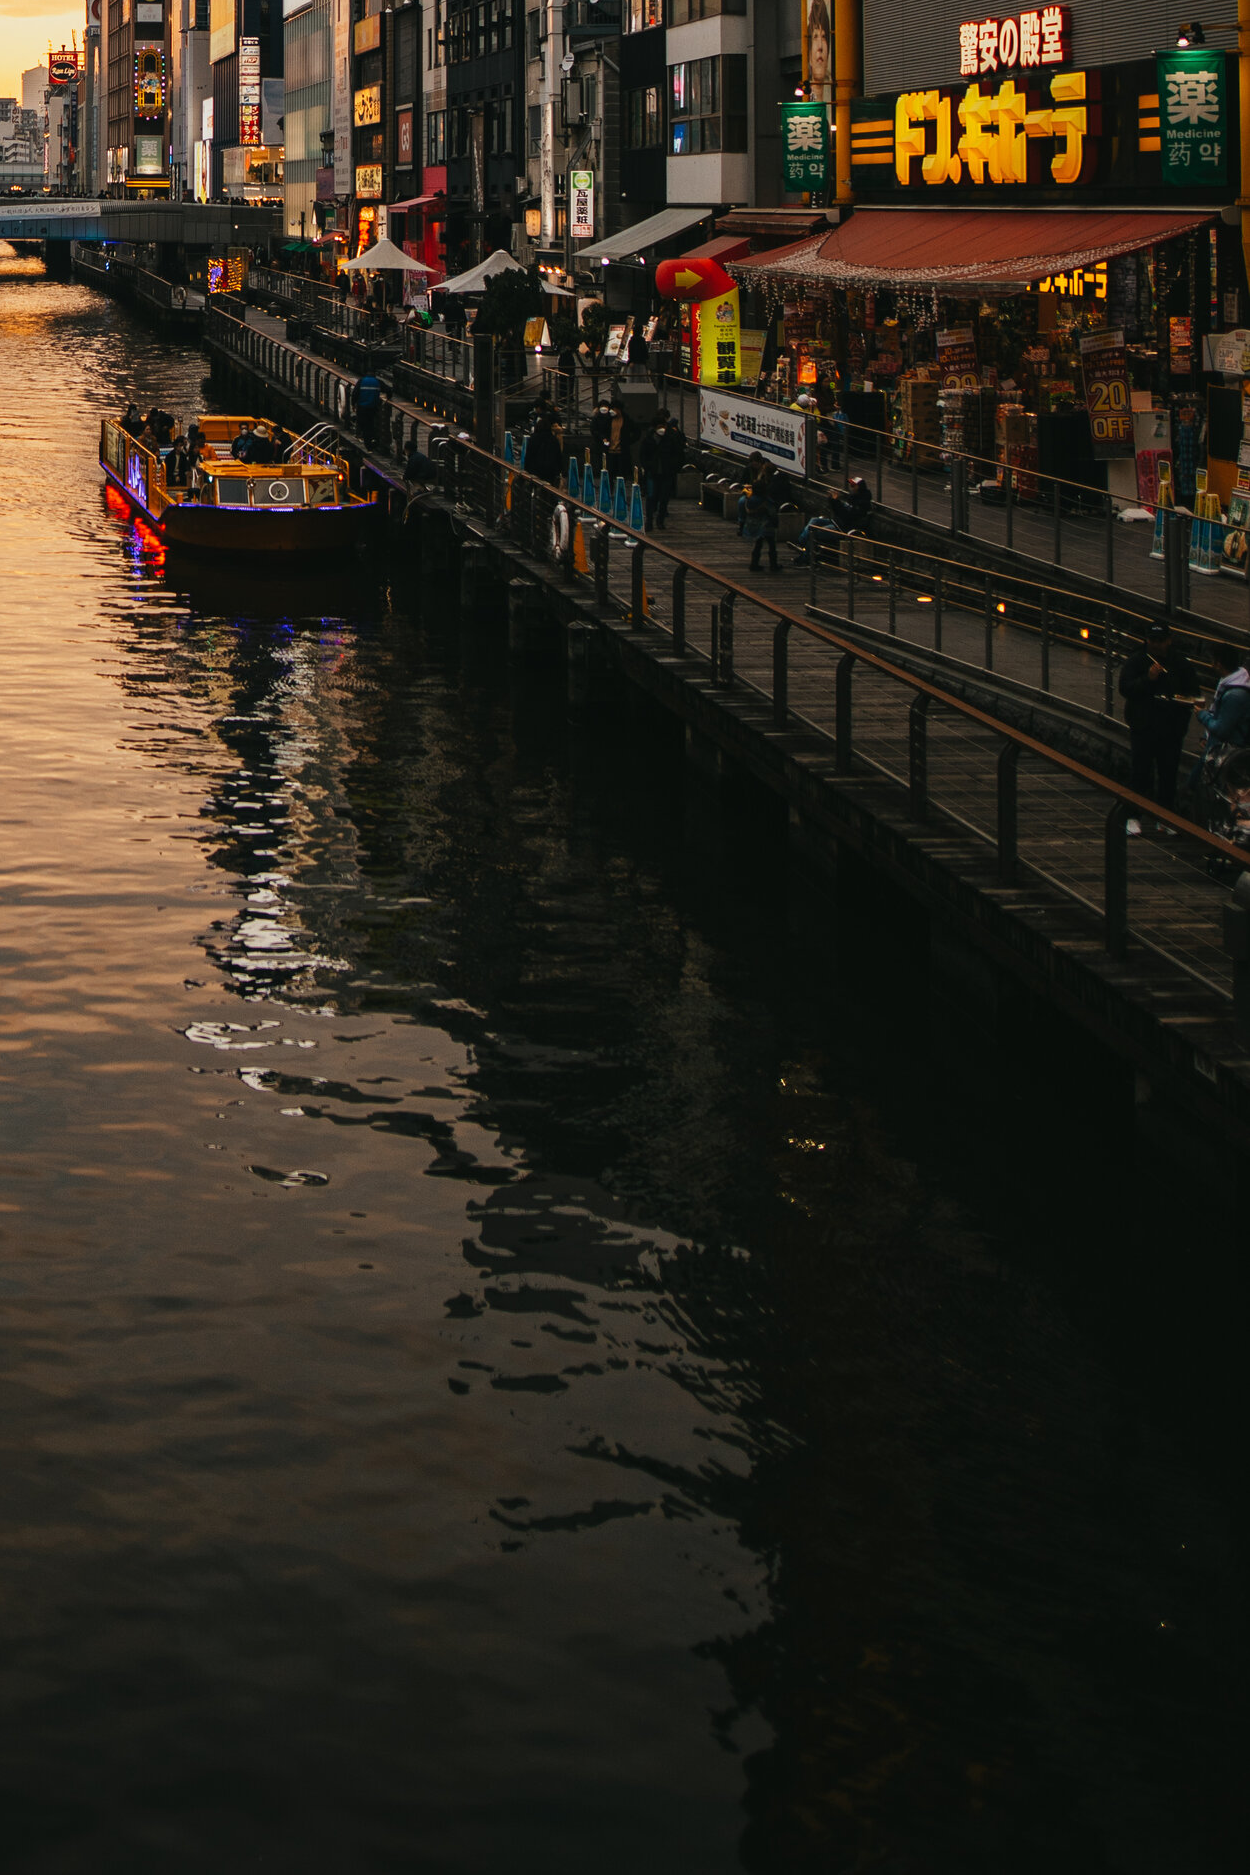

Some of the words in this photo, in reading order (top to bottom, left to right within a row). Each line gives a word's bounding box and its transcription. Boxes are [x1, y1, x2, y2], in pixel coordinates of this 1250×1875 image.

[959, 7, 1063, 74] 驚安の殿堂
[1165, 70, 1220, 125] 薬
[787, 116, 824, 151] 薬
[1166, 128, 1221, 139] Medicine
[787, 153, 825, 161] Medicine
[1167, 143, 1192, 167] 药
[1199, 144, 1222, 166] 약
[788, 162, 804, 179] 药
[717, 341, 735, 383] 観覧車
[1089, 381, 1127, 412] 20
[1092, 416, 1130, 440] OFF
